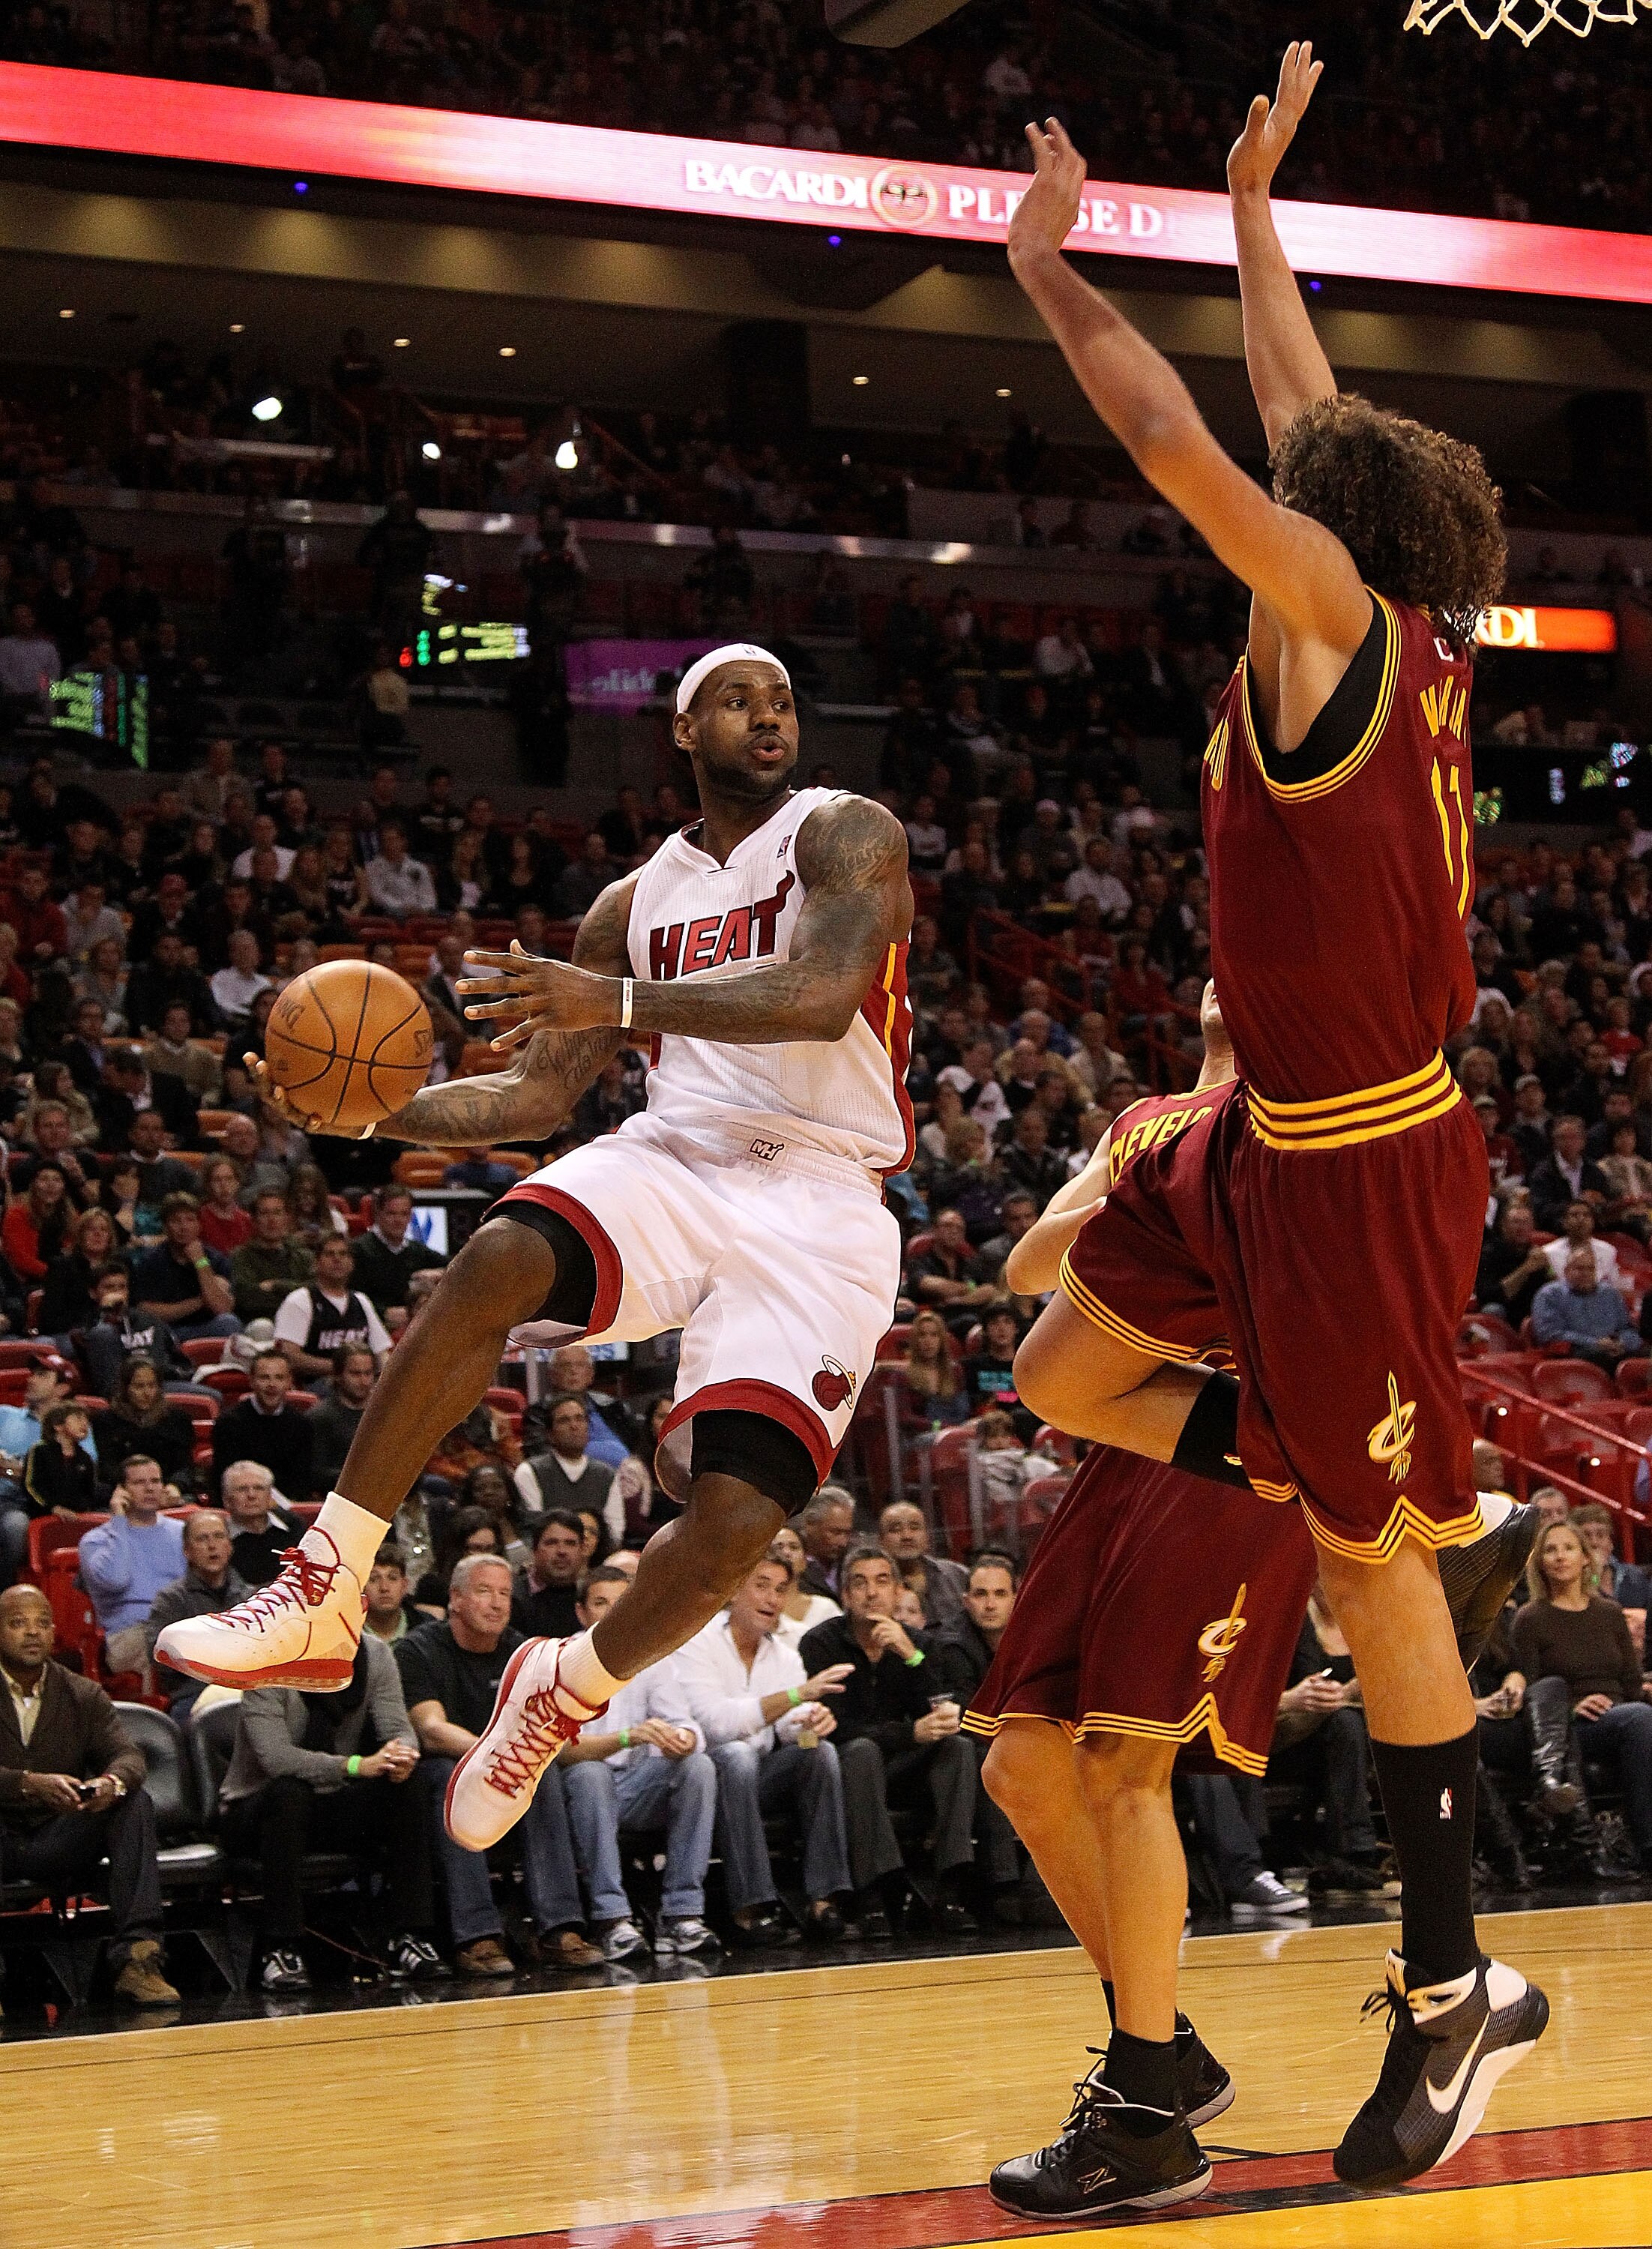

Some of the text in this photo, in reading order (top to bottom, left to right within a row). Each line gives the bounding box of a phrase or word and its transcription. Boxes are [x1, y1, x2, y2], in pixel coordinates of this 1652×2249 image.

[685, 159, 868, 208] BACARDI
[948, 184, 1119, 235] PLSE
[649, 869, 796, 981] HEAT
